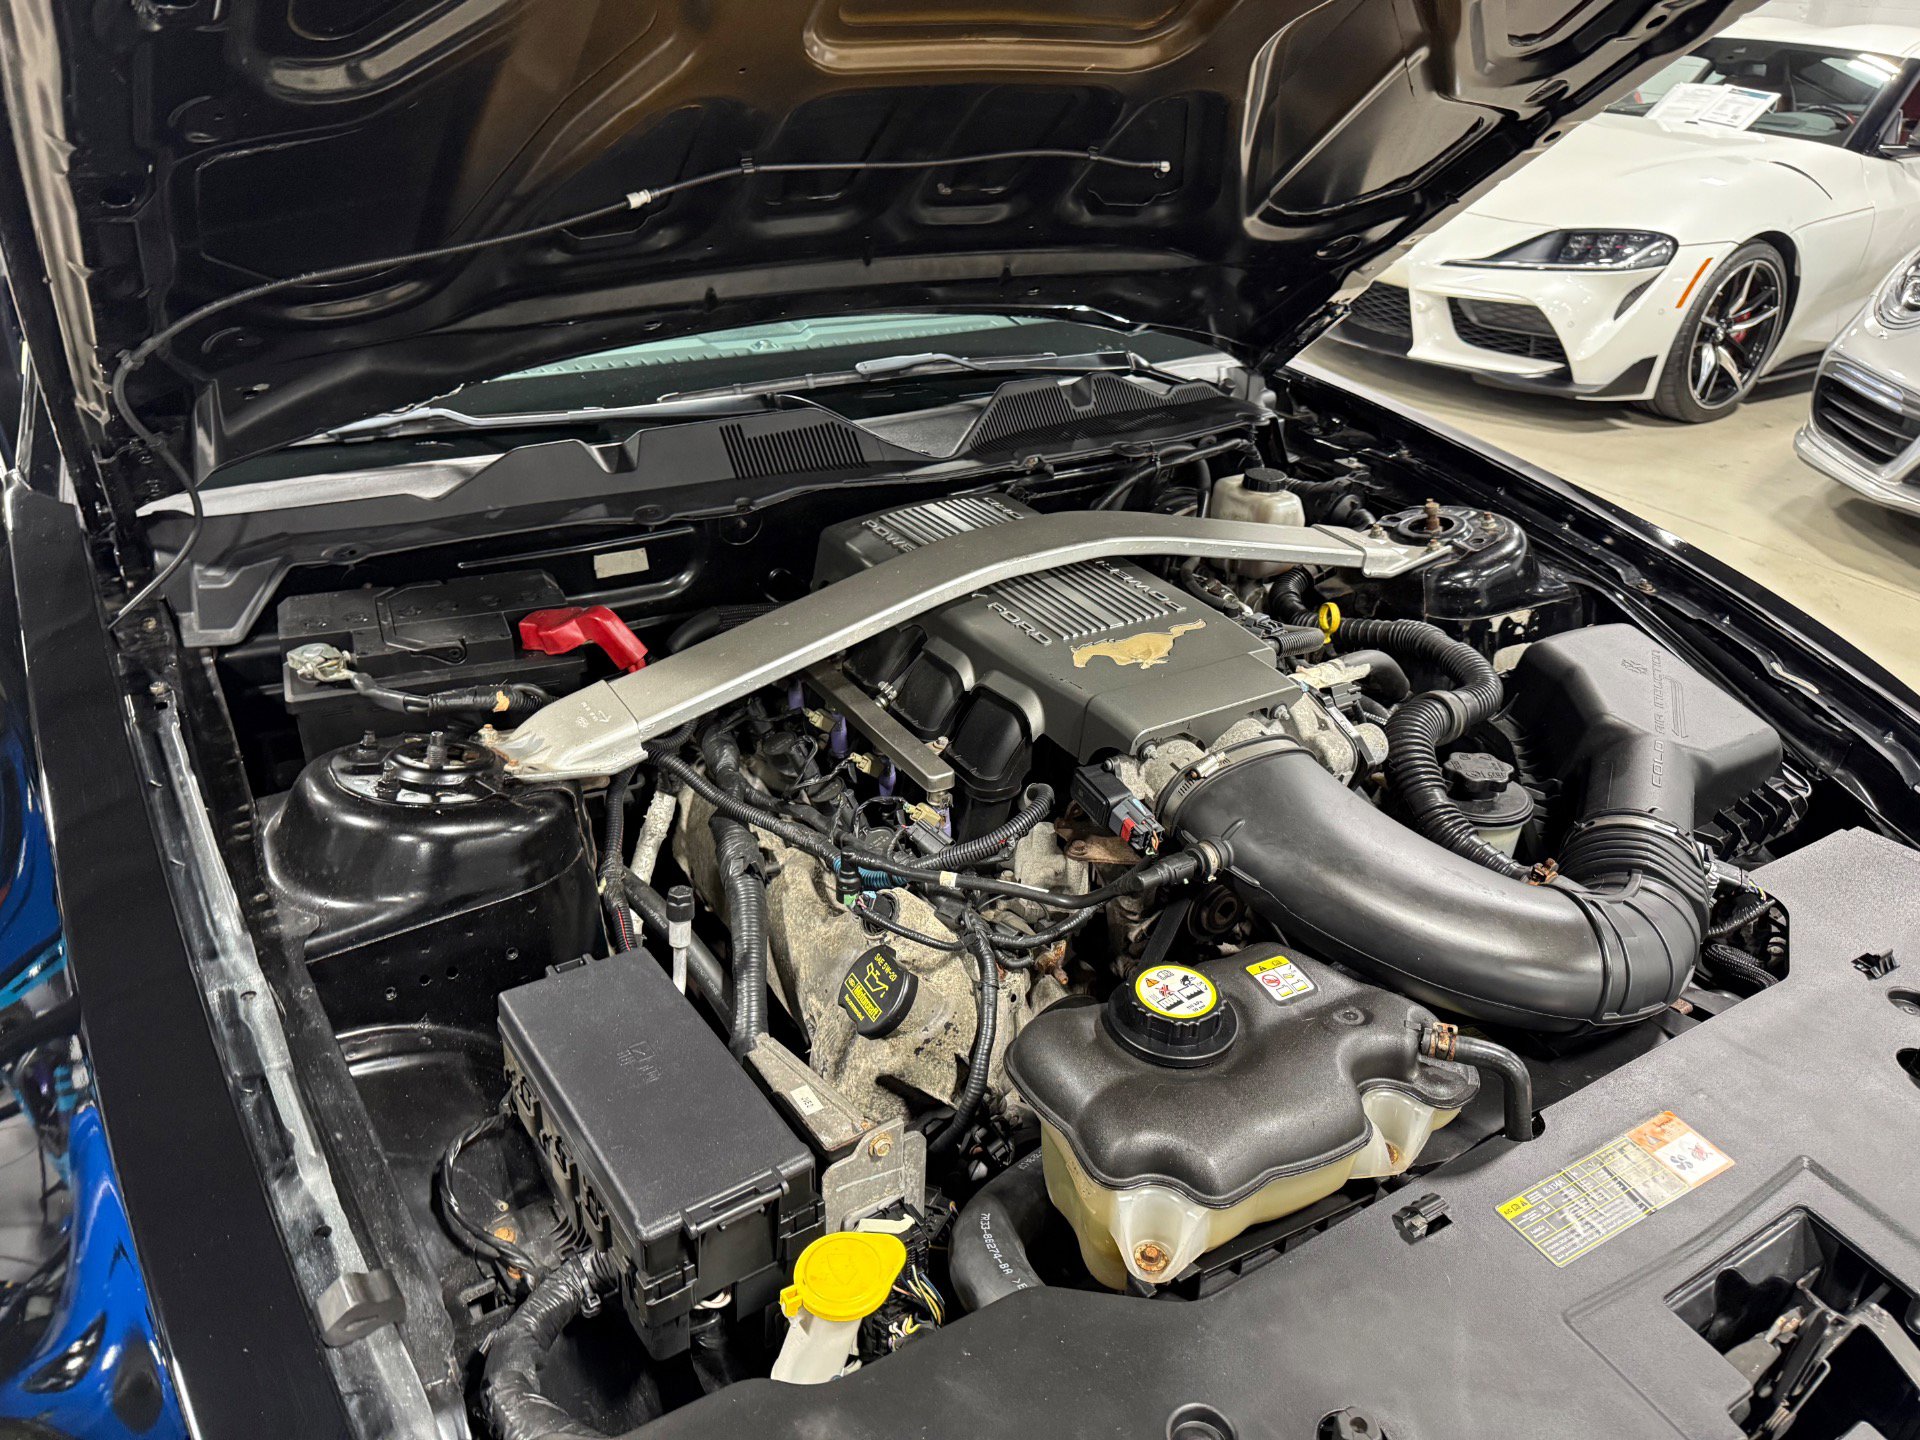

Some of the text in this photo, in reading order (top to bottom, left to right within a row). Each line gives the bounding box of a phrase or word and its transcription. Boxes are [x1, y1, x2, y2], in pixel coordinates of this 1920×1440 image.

[986, 601, 1053, 646] FORD
[1651, 650, 1665, 788] COLD AIR INDUCTION
[873, 953, 898, 982] SAE 5W-20
